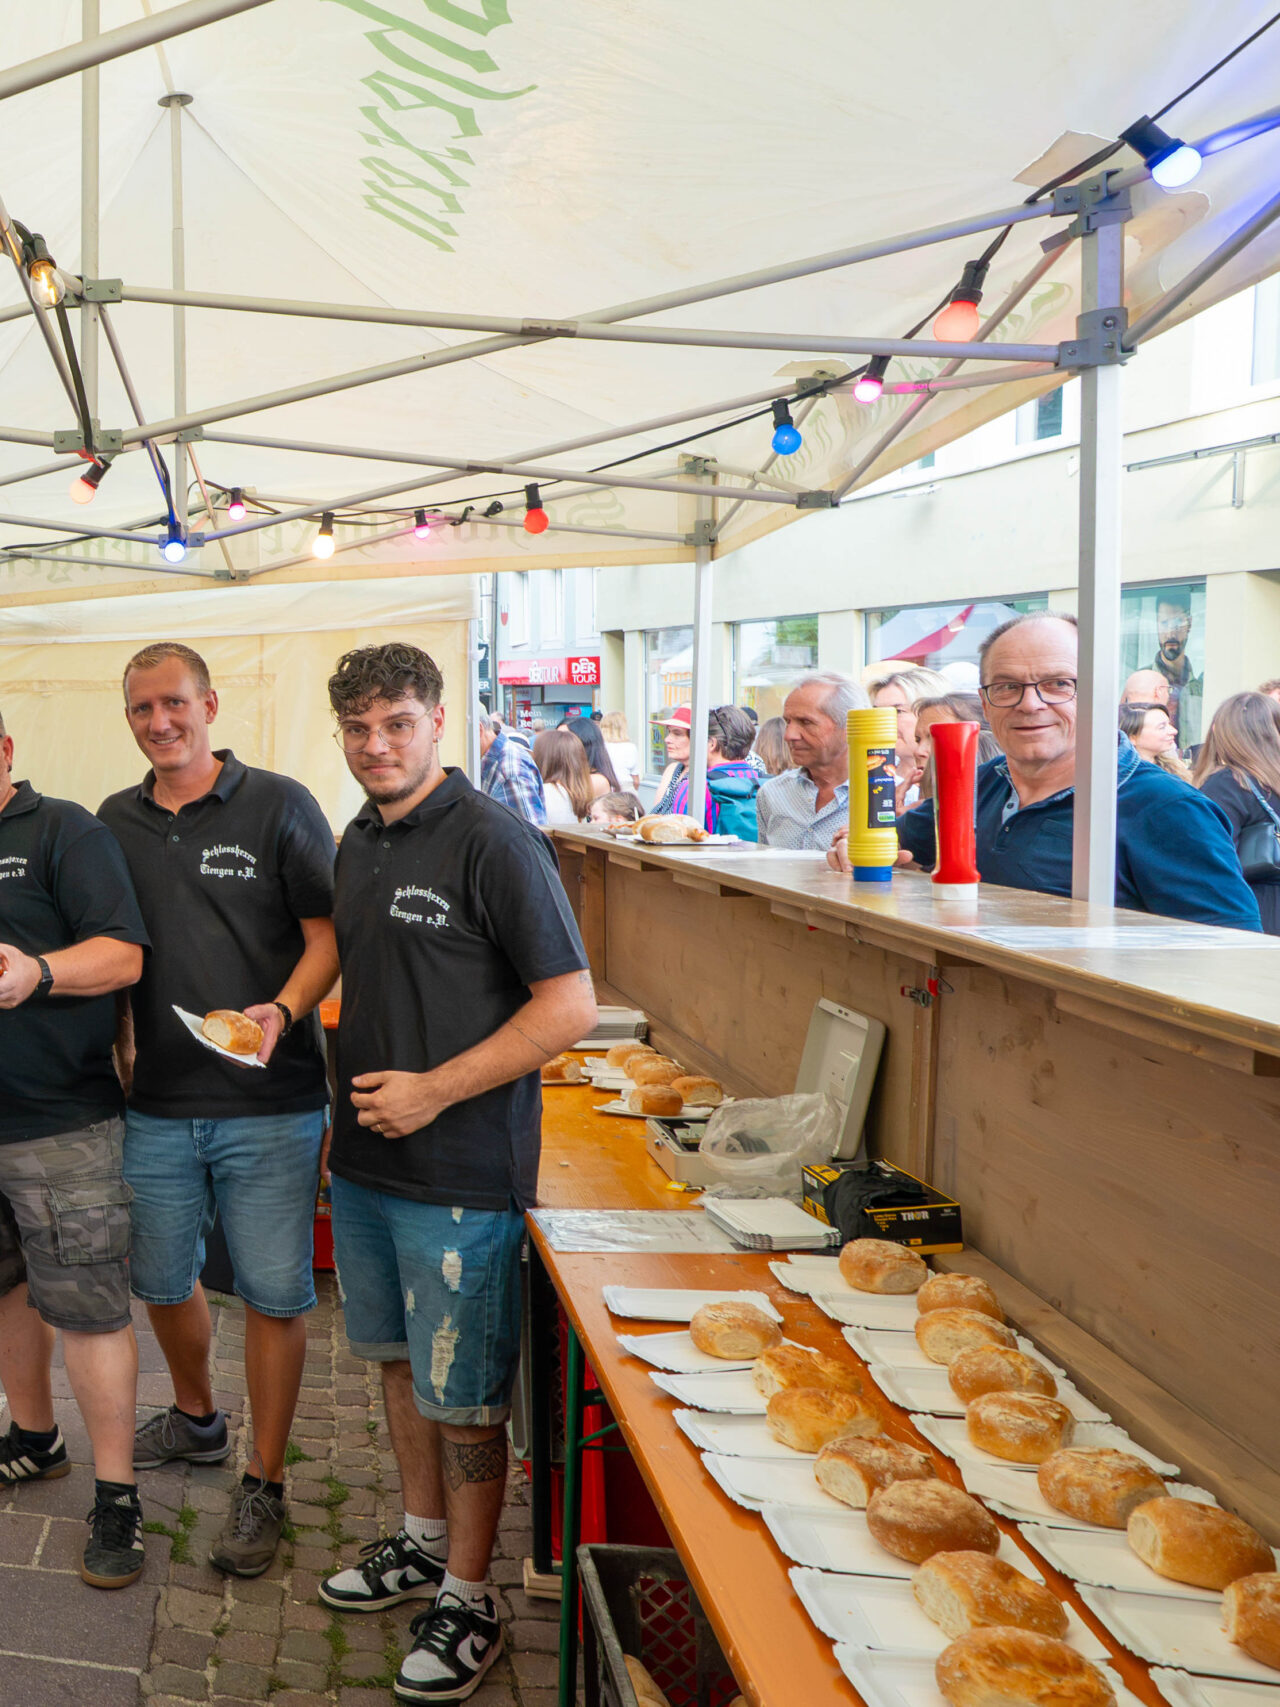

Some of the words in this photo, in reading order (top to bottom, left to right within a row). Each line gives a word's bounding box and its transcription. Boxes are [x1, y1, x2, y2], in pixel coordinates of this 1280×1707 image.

[571, 658, 598, 674] DER
[572, 674, 598, 684] TOUR
[520, 709, 542, 718] Mein
[202, 843, 257, 865] Schlosshexen
[200, 863, 234, 878] Tiengen
[393, 884, 451, 912] Schlosshexen
[390, 904, 423, 924] Tiengen
